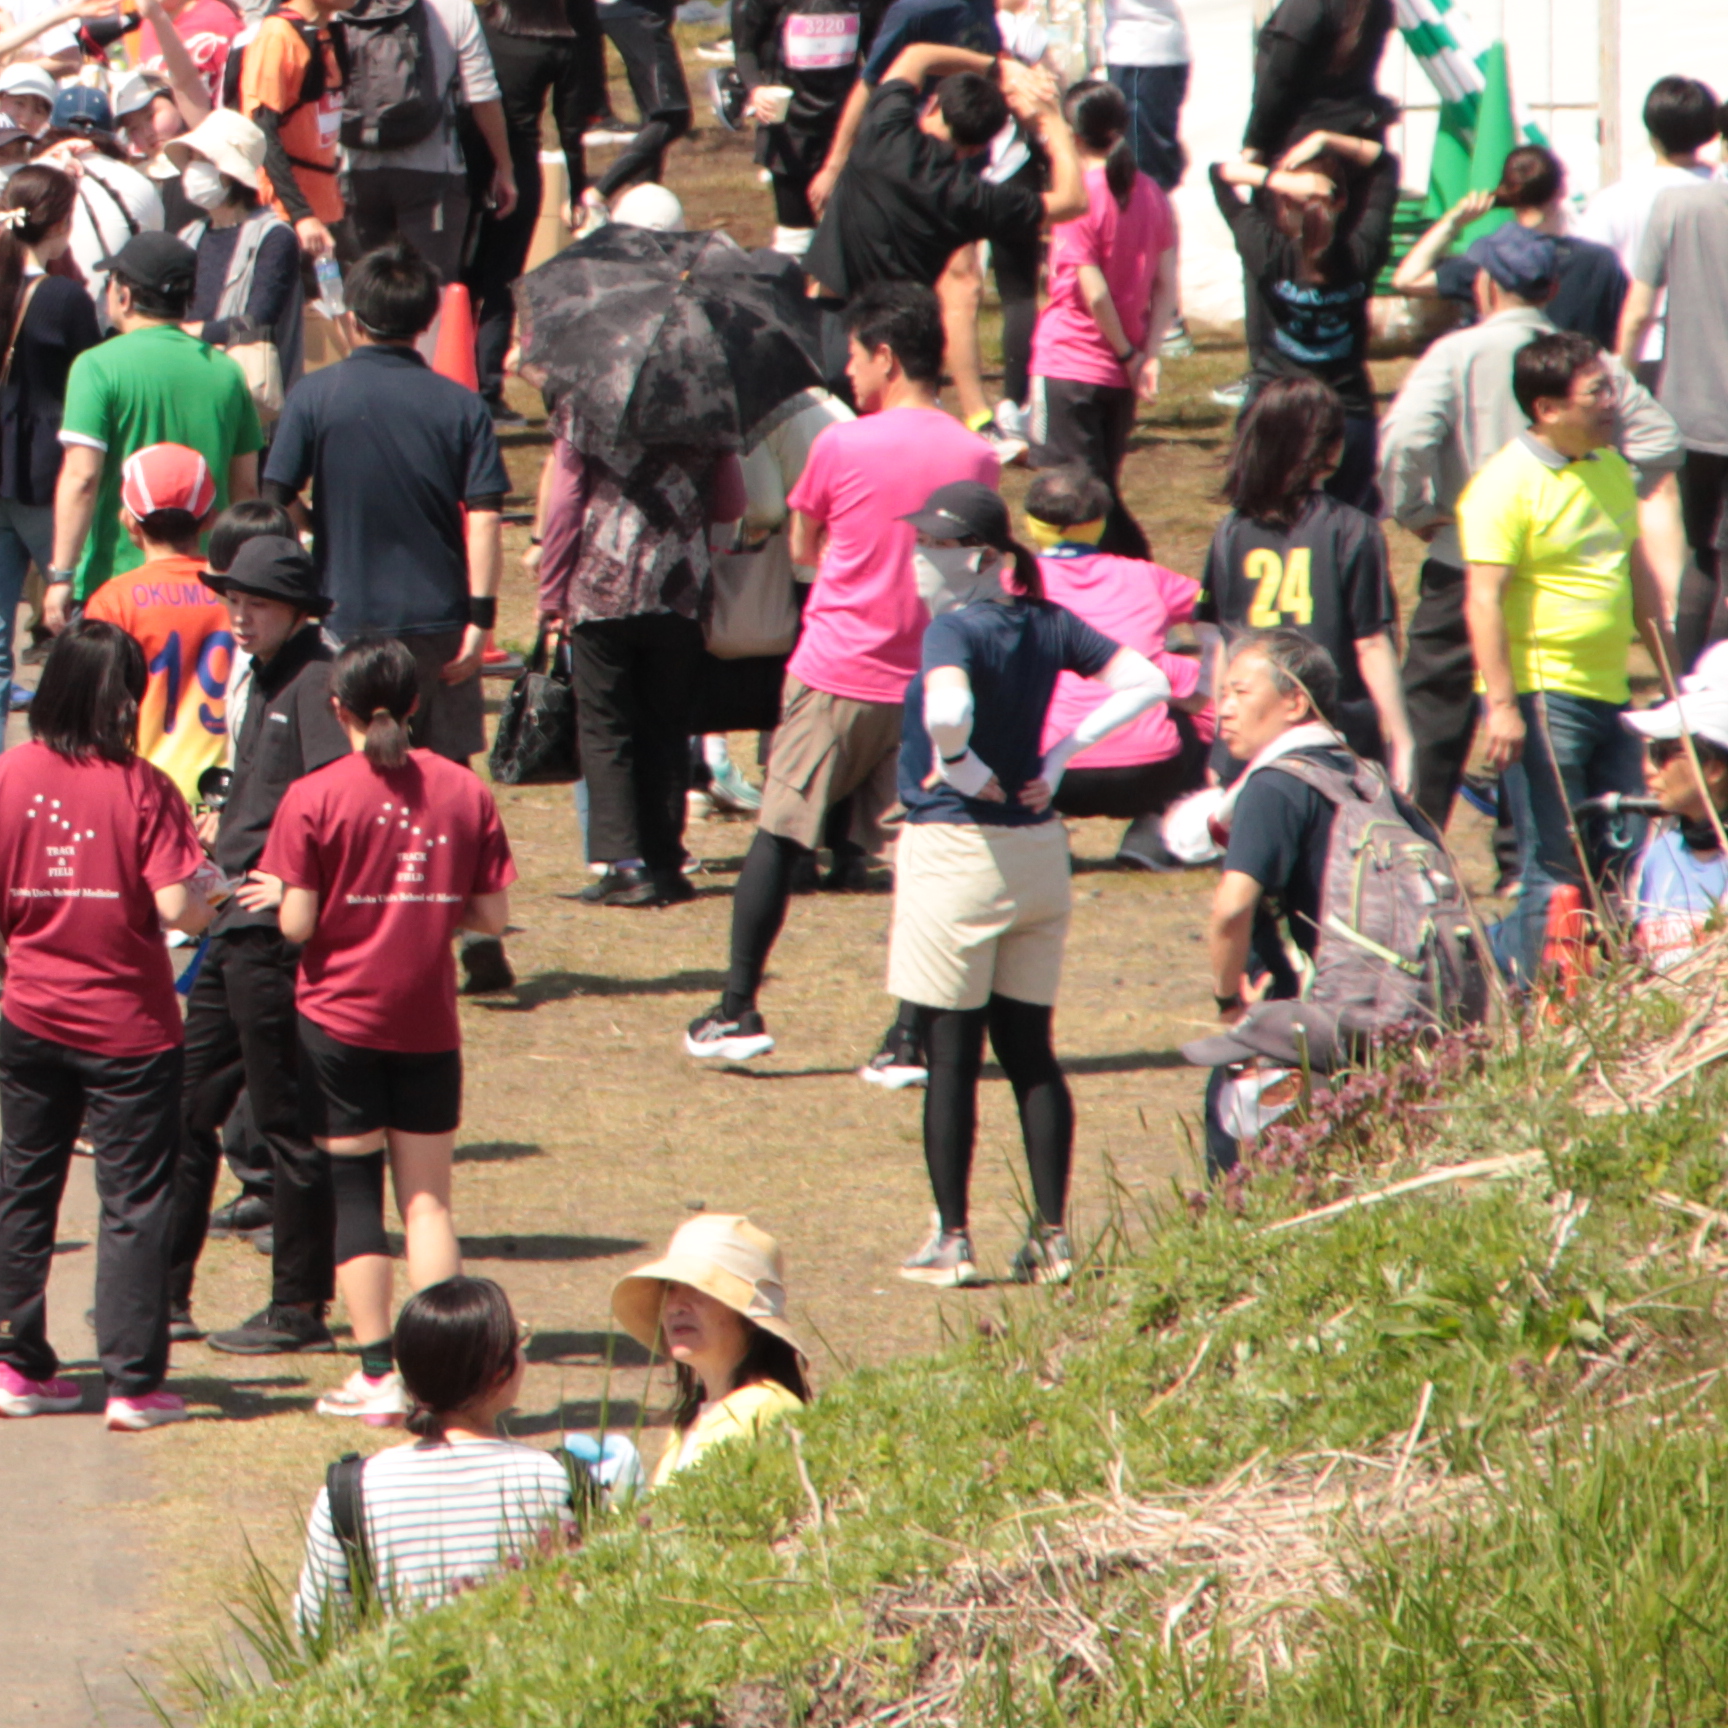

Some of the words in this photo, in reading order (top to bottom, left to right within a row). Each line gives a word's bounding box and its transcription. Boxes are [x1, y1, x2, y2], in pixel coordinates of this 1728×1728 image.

[805, 17, 846, 33] 3220
[1244, 547, 1313, 627] 24
[150, 630, 237, 735] 19
[46, 846, 76, 857] TRACK
[48, 866, 75, 877] FIELD
[397, 872, 425, 882] FIELD
